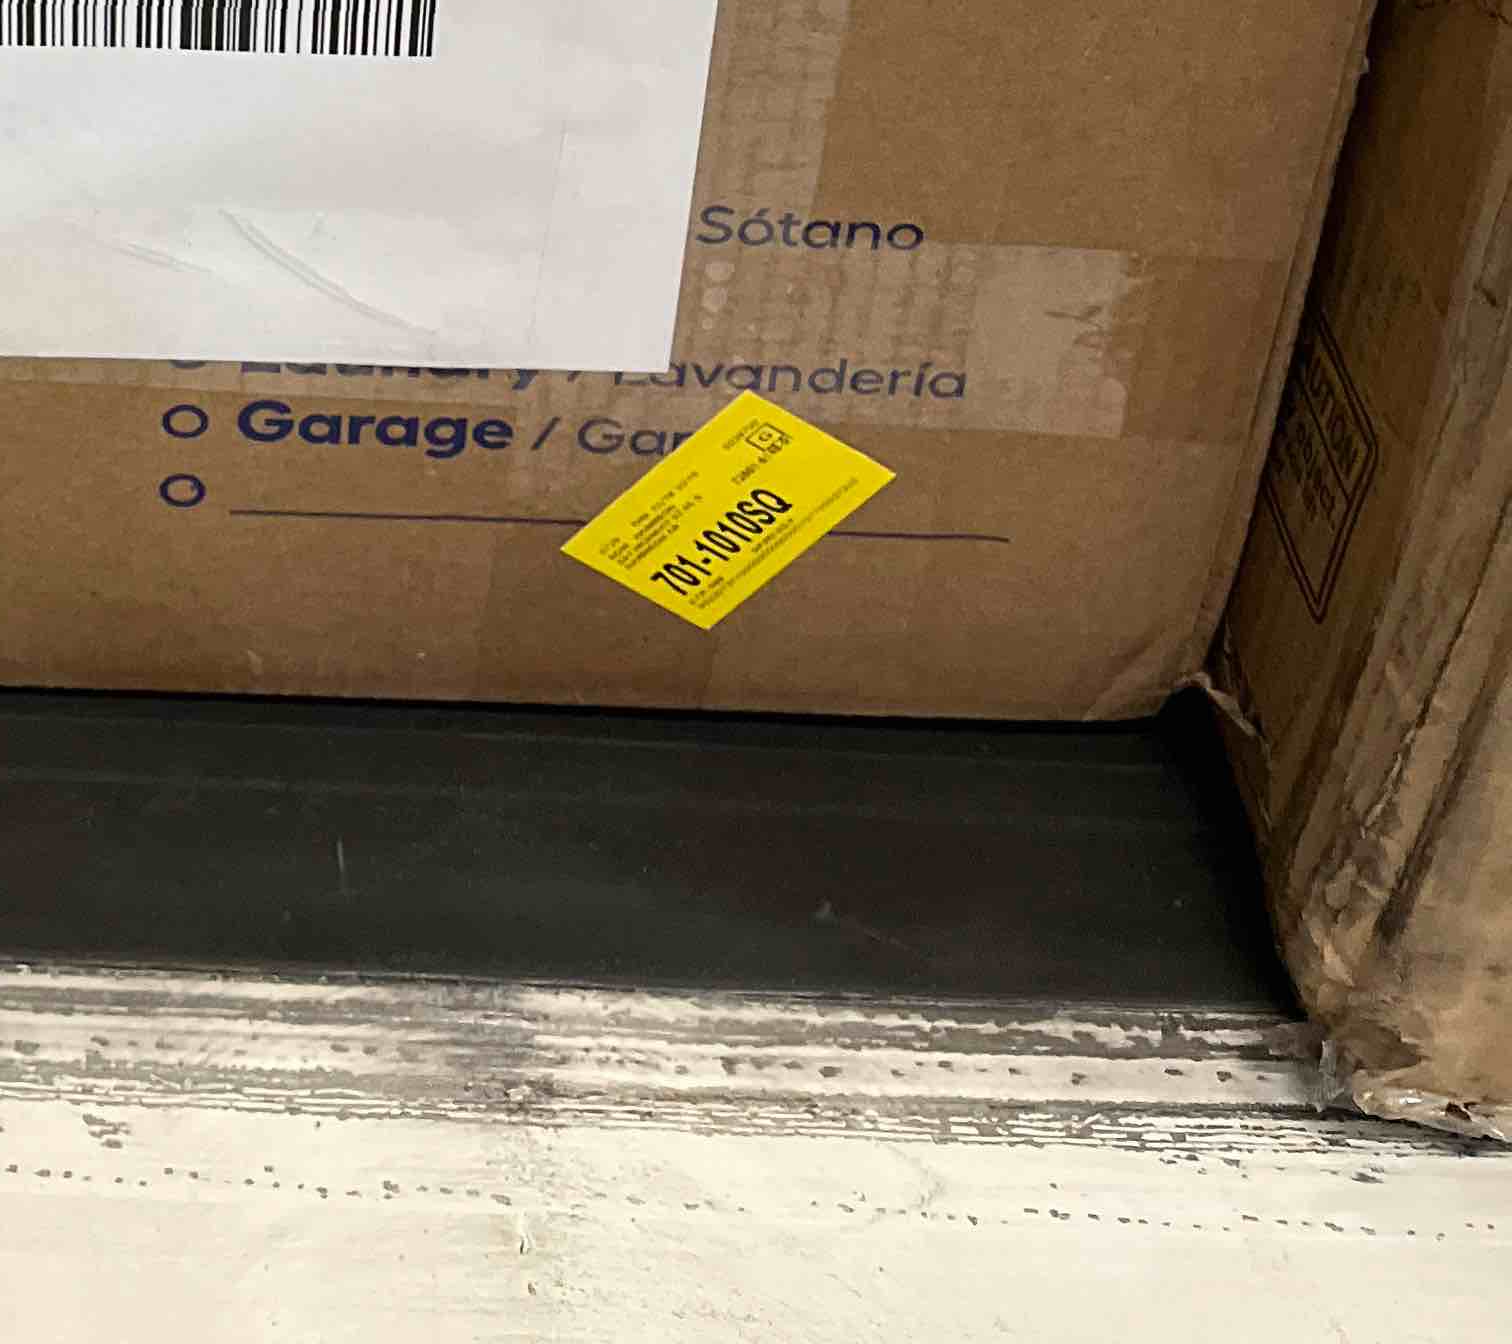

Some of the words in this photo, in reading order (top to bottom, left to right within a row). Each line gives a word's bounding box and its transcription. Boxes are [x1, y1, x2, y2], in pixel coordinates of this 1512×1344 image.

[695, 205, 926, 252] Sótano
[237, 399, 515, 459] Garage
[649, 487, 794, 597] 701-1010SQ
